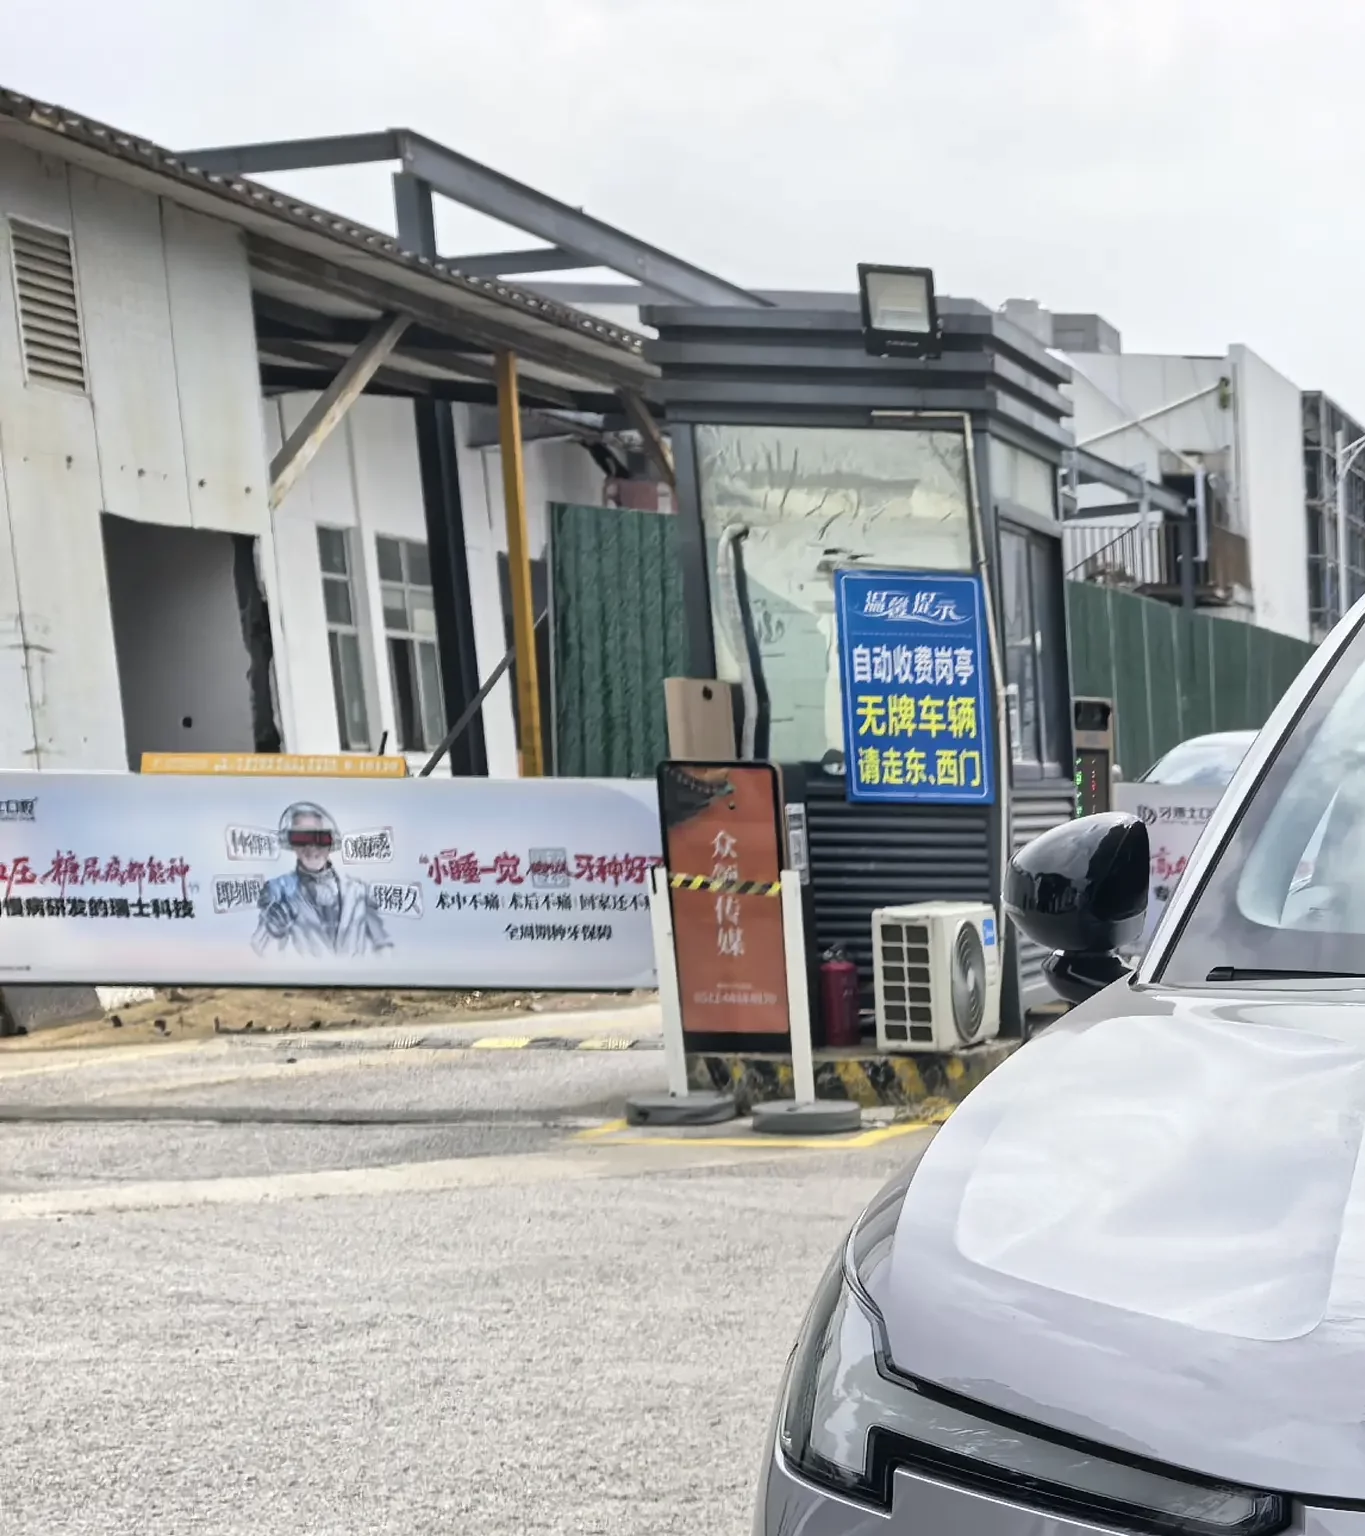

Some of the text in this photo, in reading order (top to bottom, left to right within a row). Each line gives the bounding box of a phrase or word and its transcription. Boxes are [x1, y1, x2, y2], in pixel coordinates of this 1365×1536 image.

[864, 590, 966, 621] 温馨提示
[852, 644, 975, 686] 自动收费岗亭
[856, 694, 977, 739] 无牌车辆
[857, 745, 982, 787] 请走东、西门
